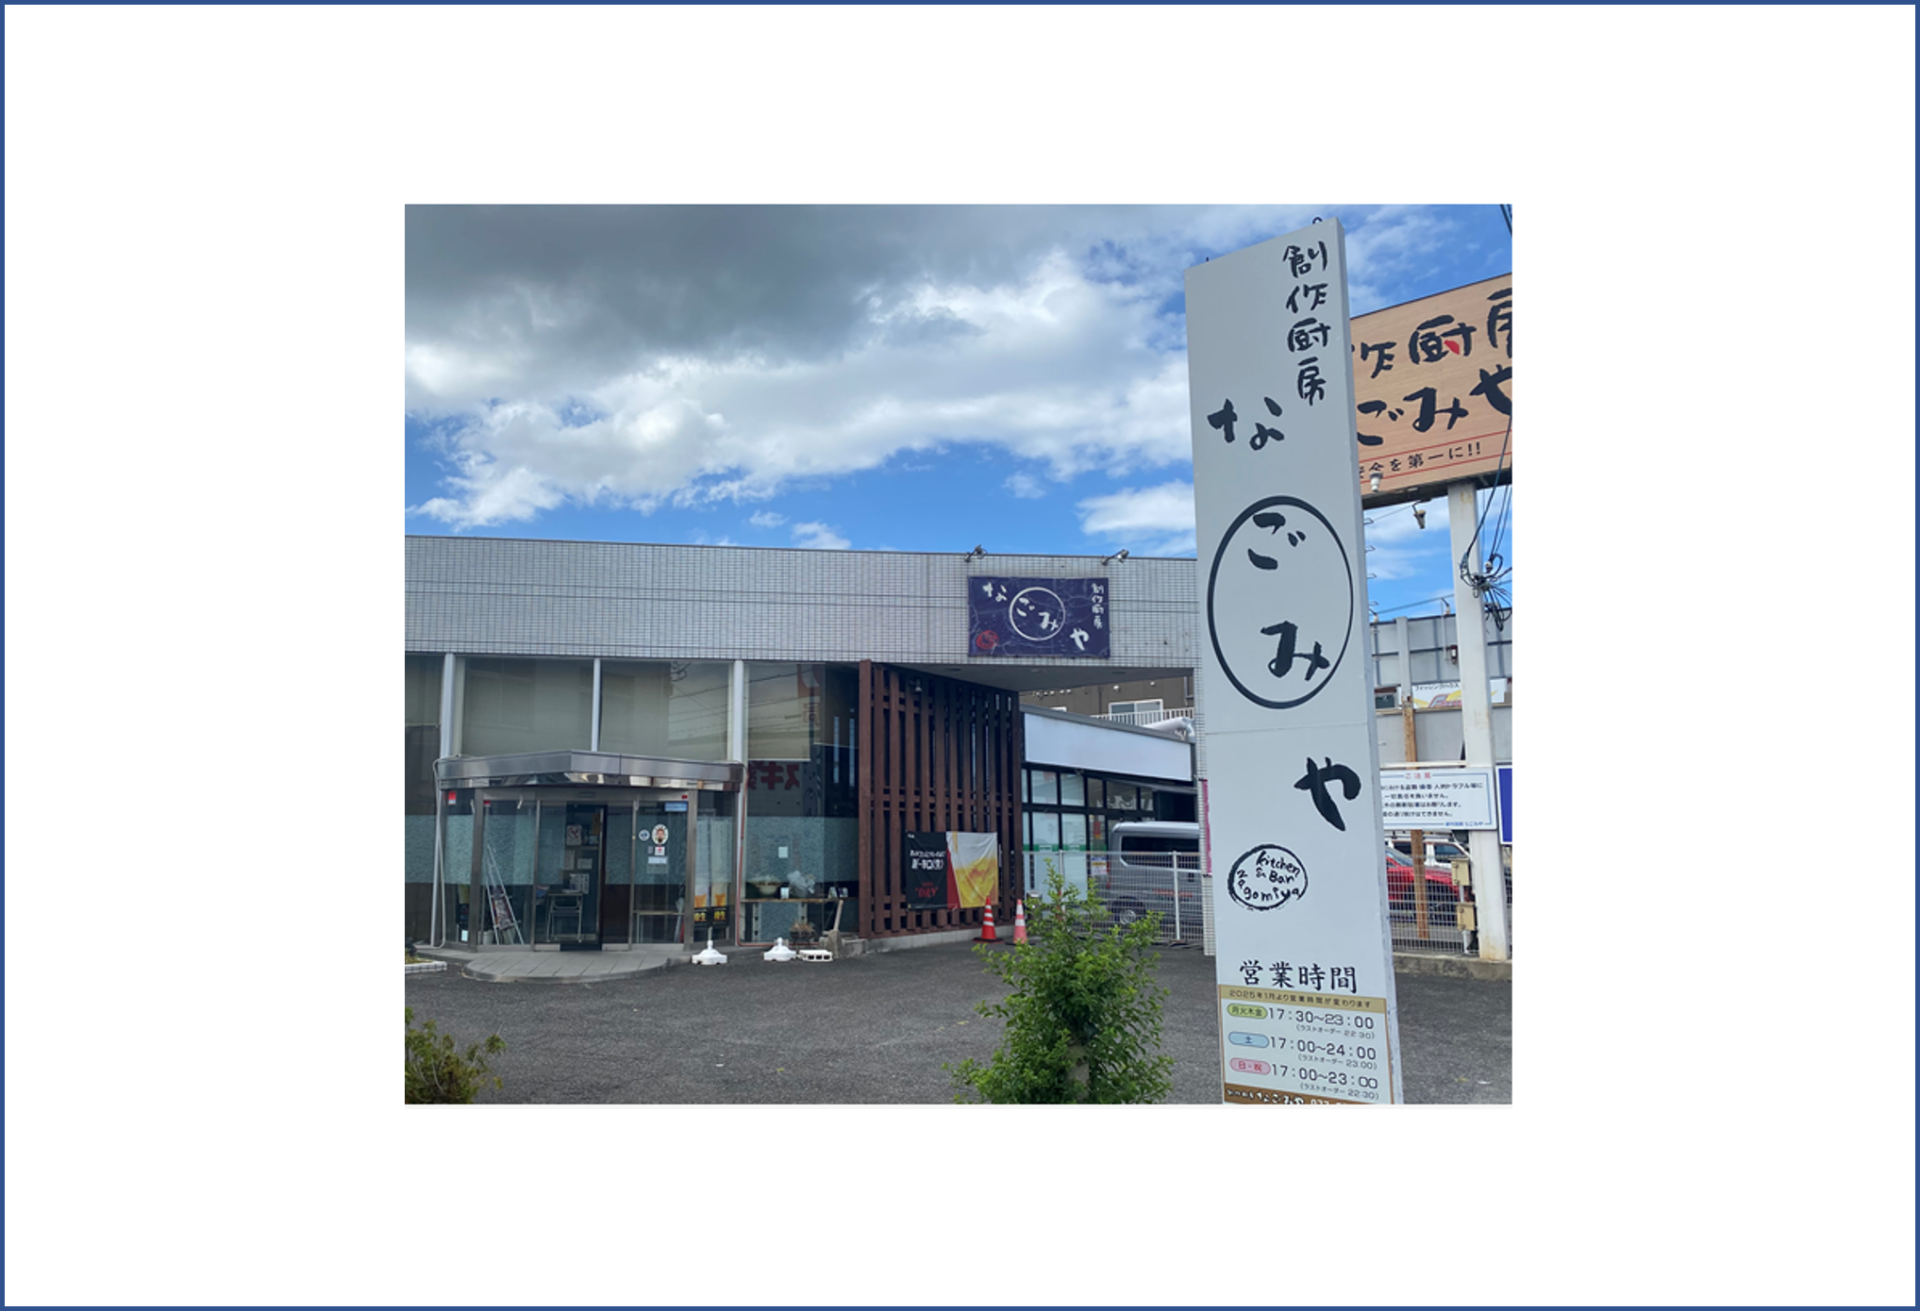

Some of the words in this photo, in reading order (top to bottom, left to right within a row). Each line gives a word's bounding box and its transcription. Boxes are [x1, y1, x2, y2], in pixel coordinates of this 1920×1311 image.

[1283, 241, 1331, 406] 創作厨房
[1359, 442, 1481, 479] 全を第一に!!
[1239, 960, 1358, 994] 営業時間
